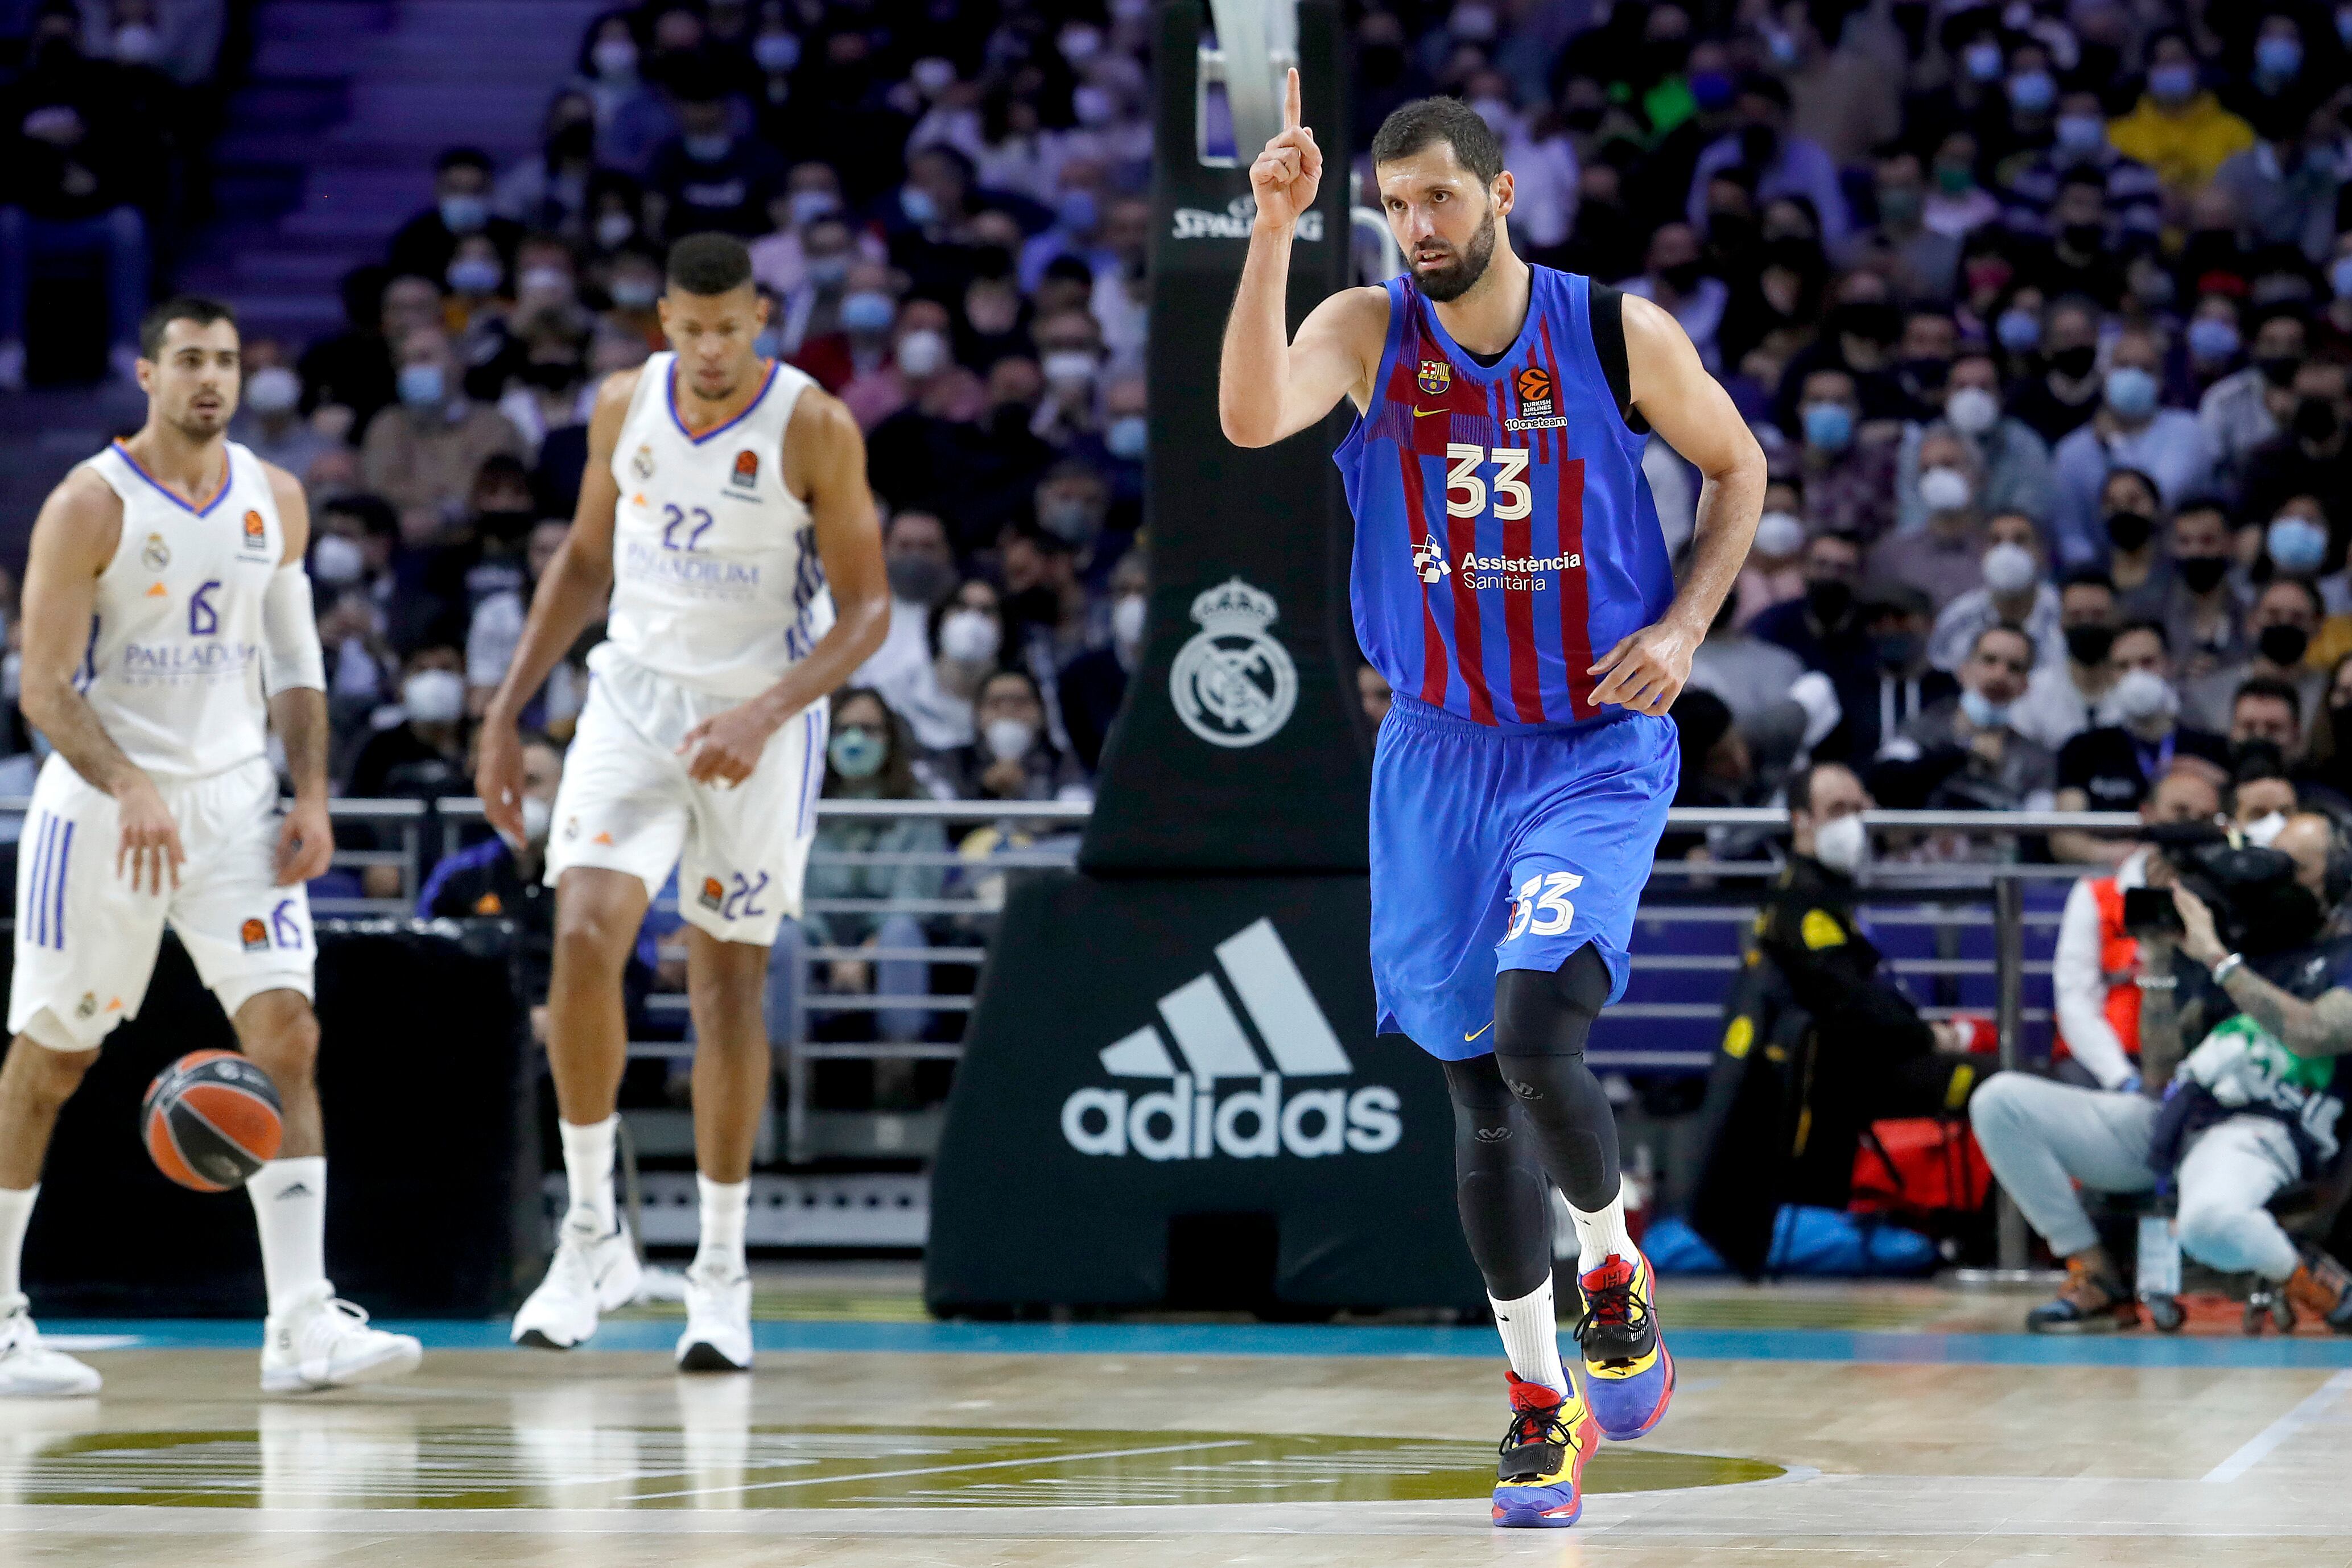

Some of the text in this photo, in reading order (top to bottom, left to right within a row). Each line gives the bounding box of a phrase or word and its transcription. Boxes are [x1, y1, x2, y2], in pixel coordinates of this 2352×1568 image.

[1171, 208, 1324, 241] SPALG
[1522, 399, 1552, 408] TURKISH
[1523, 405, 1552, 413] AIRLINES
[1446, 443, 1533, 521] 33
[663, 504, 715, 551] 22
[1461, 551, 1581, 572] Assistència
[1463, 572, 1546, 591] Sanitària
[189, 580, 220, 636] 6
[723, 870, 769, 921] 22
[273, 898, 302, 949] 6
[1061, 1072, 1402, 1161] adidas
